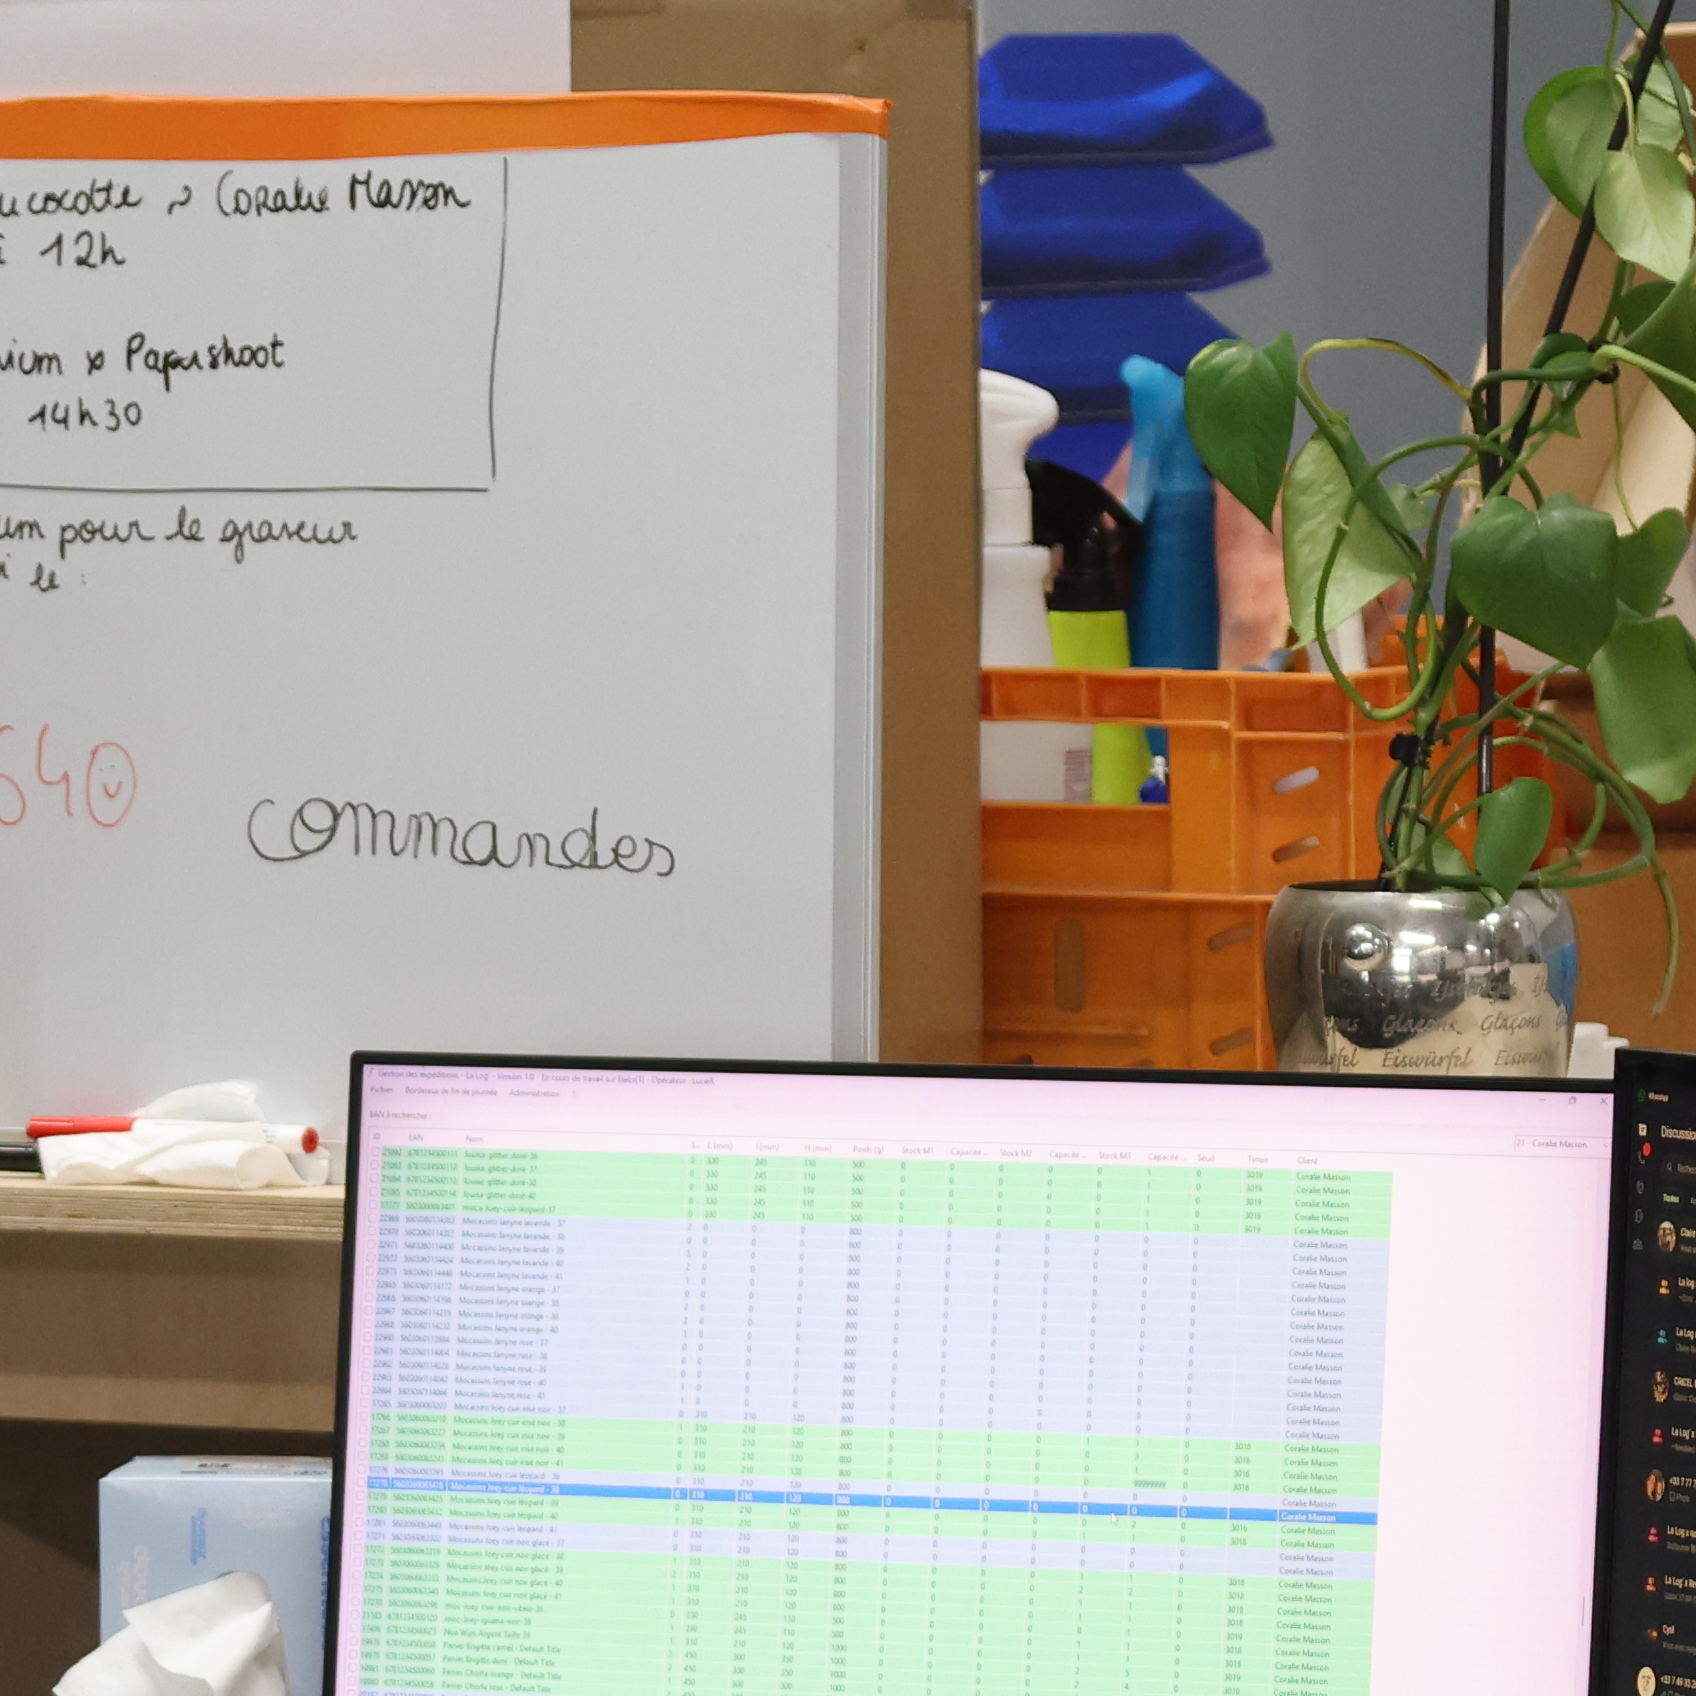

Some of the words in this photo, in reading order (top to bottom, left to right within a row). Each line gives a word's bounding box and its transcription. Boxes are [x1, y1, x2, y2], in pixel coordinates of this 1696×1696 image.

[39, 230, 126, 270] 12h
[27, 396, 142, 432] 14h30
[58, 515, 157, 562] pour
[163, 505, 206, 546] le
[1382, 1049, 1472, 1074] Eiswürfel
